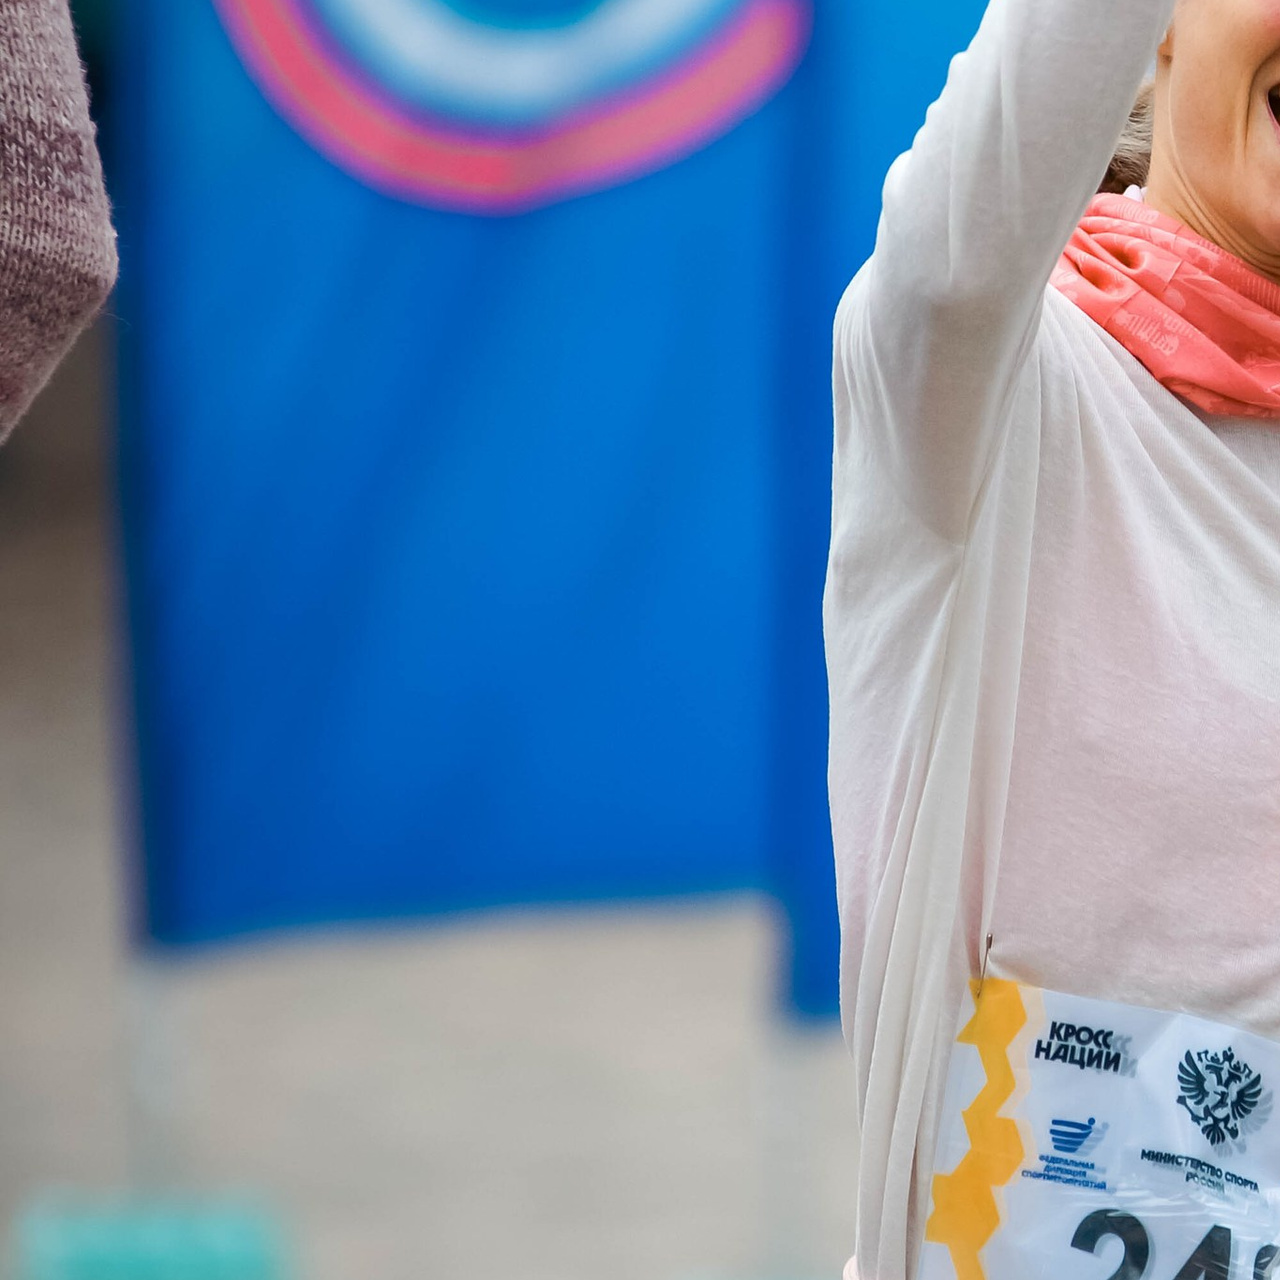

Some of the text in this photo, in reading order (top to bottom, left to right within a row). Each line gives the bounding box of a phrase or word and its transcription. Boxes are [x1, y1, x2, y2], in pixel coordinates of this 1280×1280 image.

[1049, 1021, 1114, 1050] КРОСС
[1035, 1040, 1121, 1073] НАЦИИ
[1140, 1149, 1260, 1193] МИНИСТЕРСТВО СПОРТА
